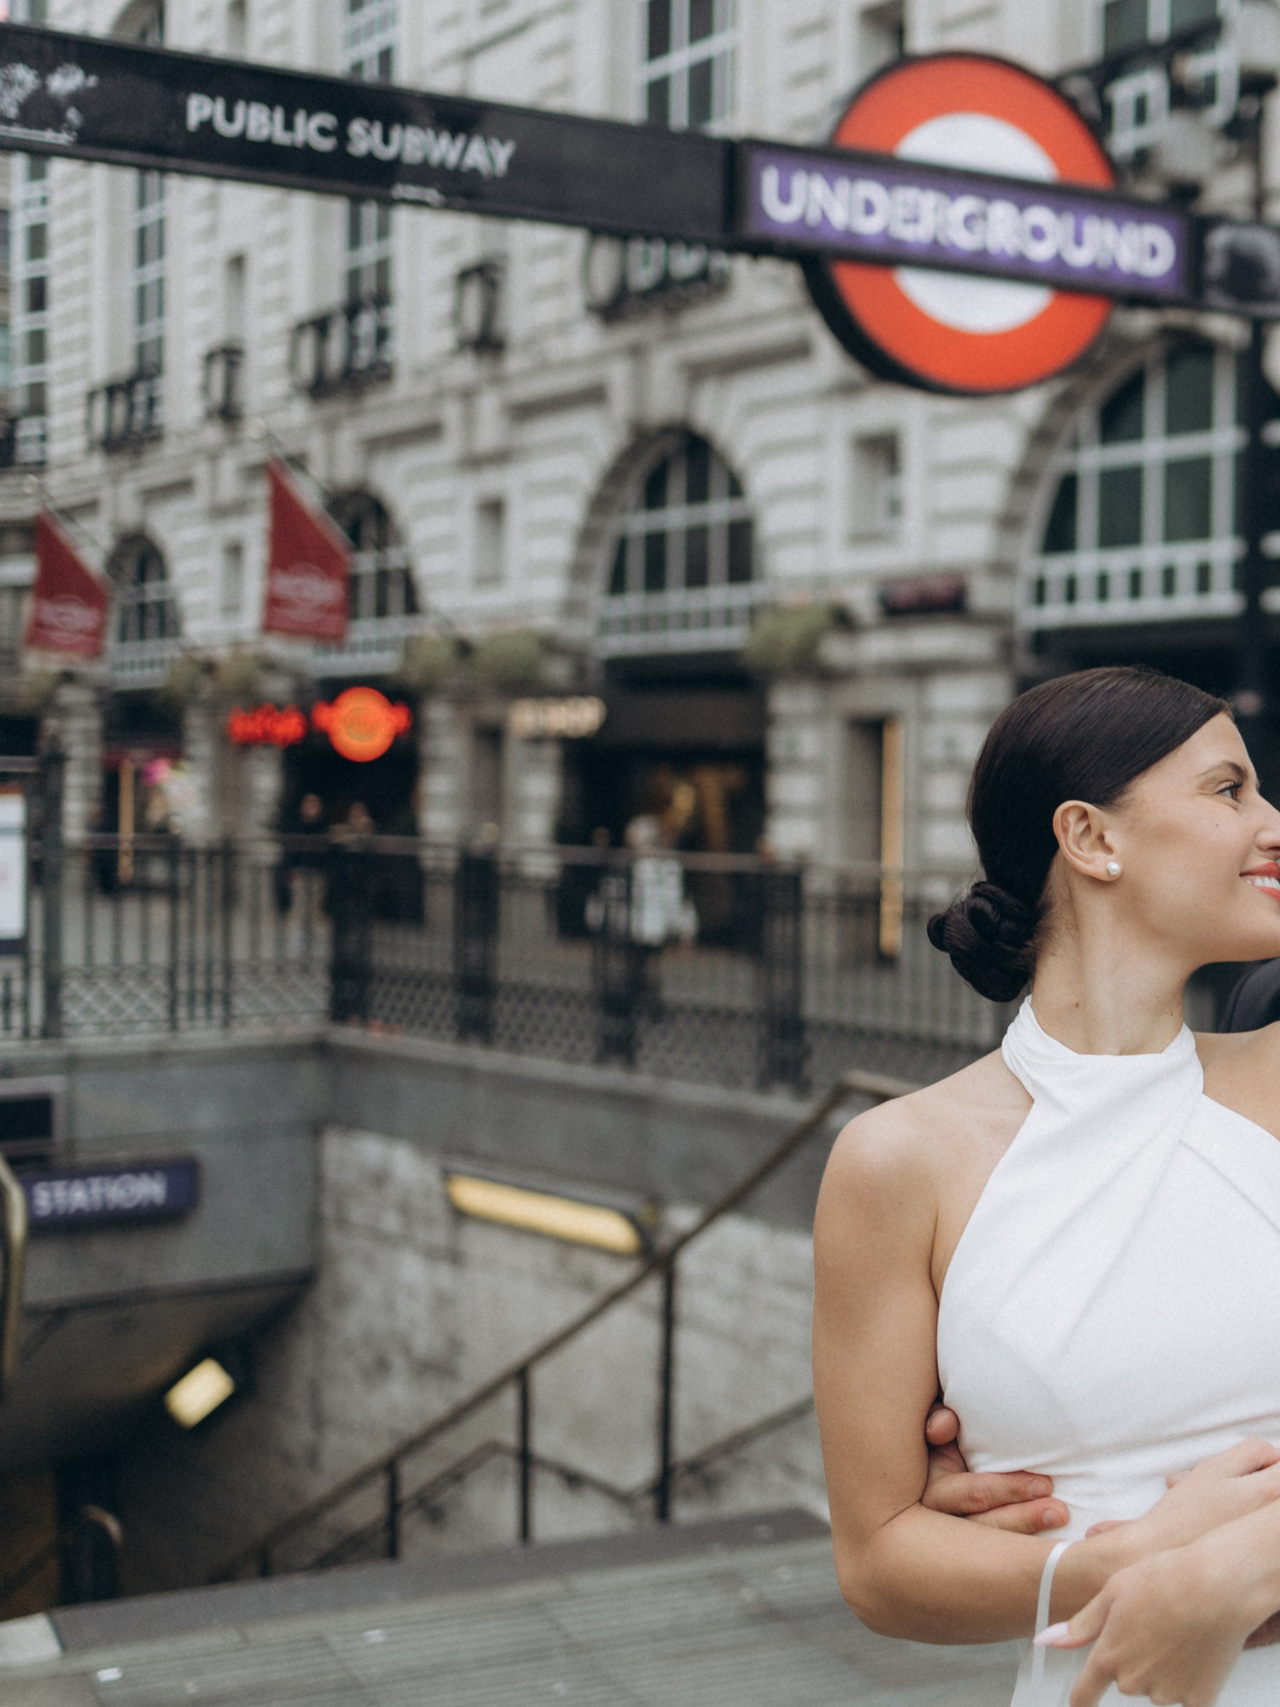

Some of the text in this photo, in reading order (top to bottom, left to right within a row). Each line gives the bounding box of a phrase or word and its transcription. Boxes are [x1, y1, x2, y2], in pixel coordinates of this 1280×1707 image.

[186, 92, 516, 178] PUBLIC SUBWAY
[760, 164, 1177, 278] UNDERGROUND
[33, 1170, 167, 1218] STATION
